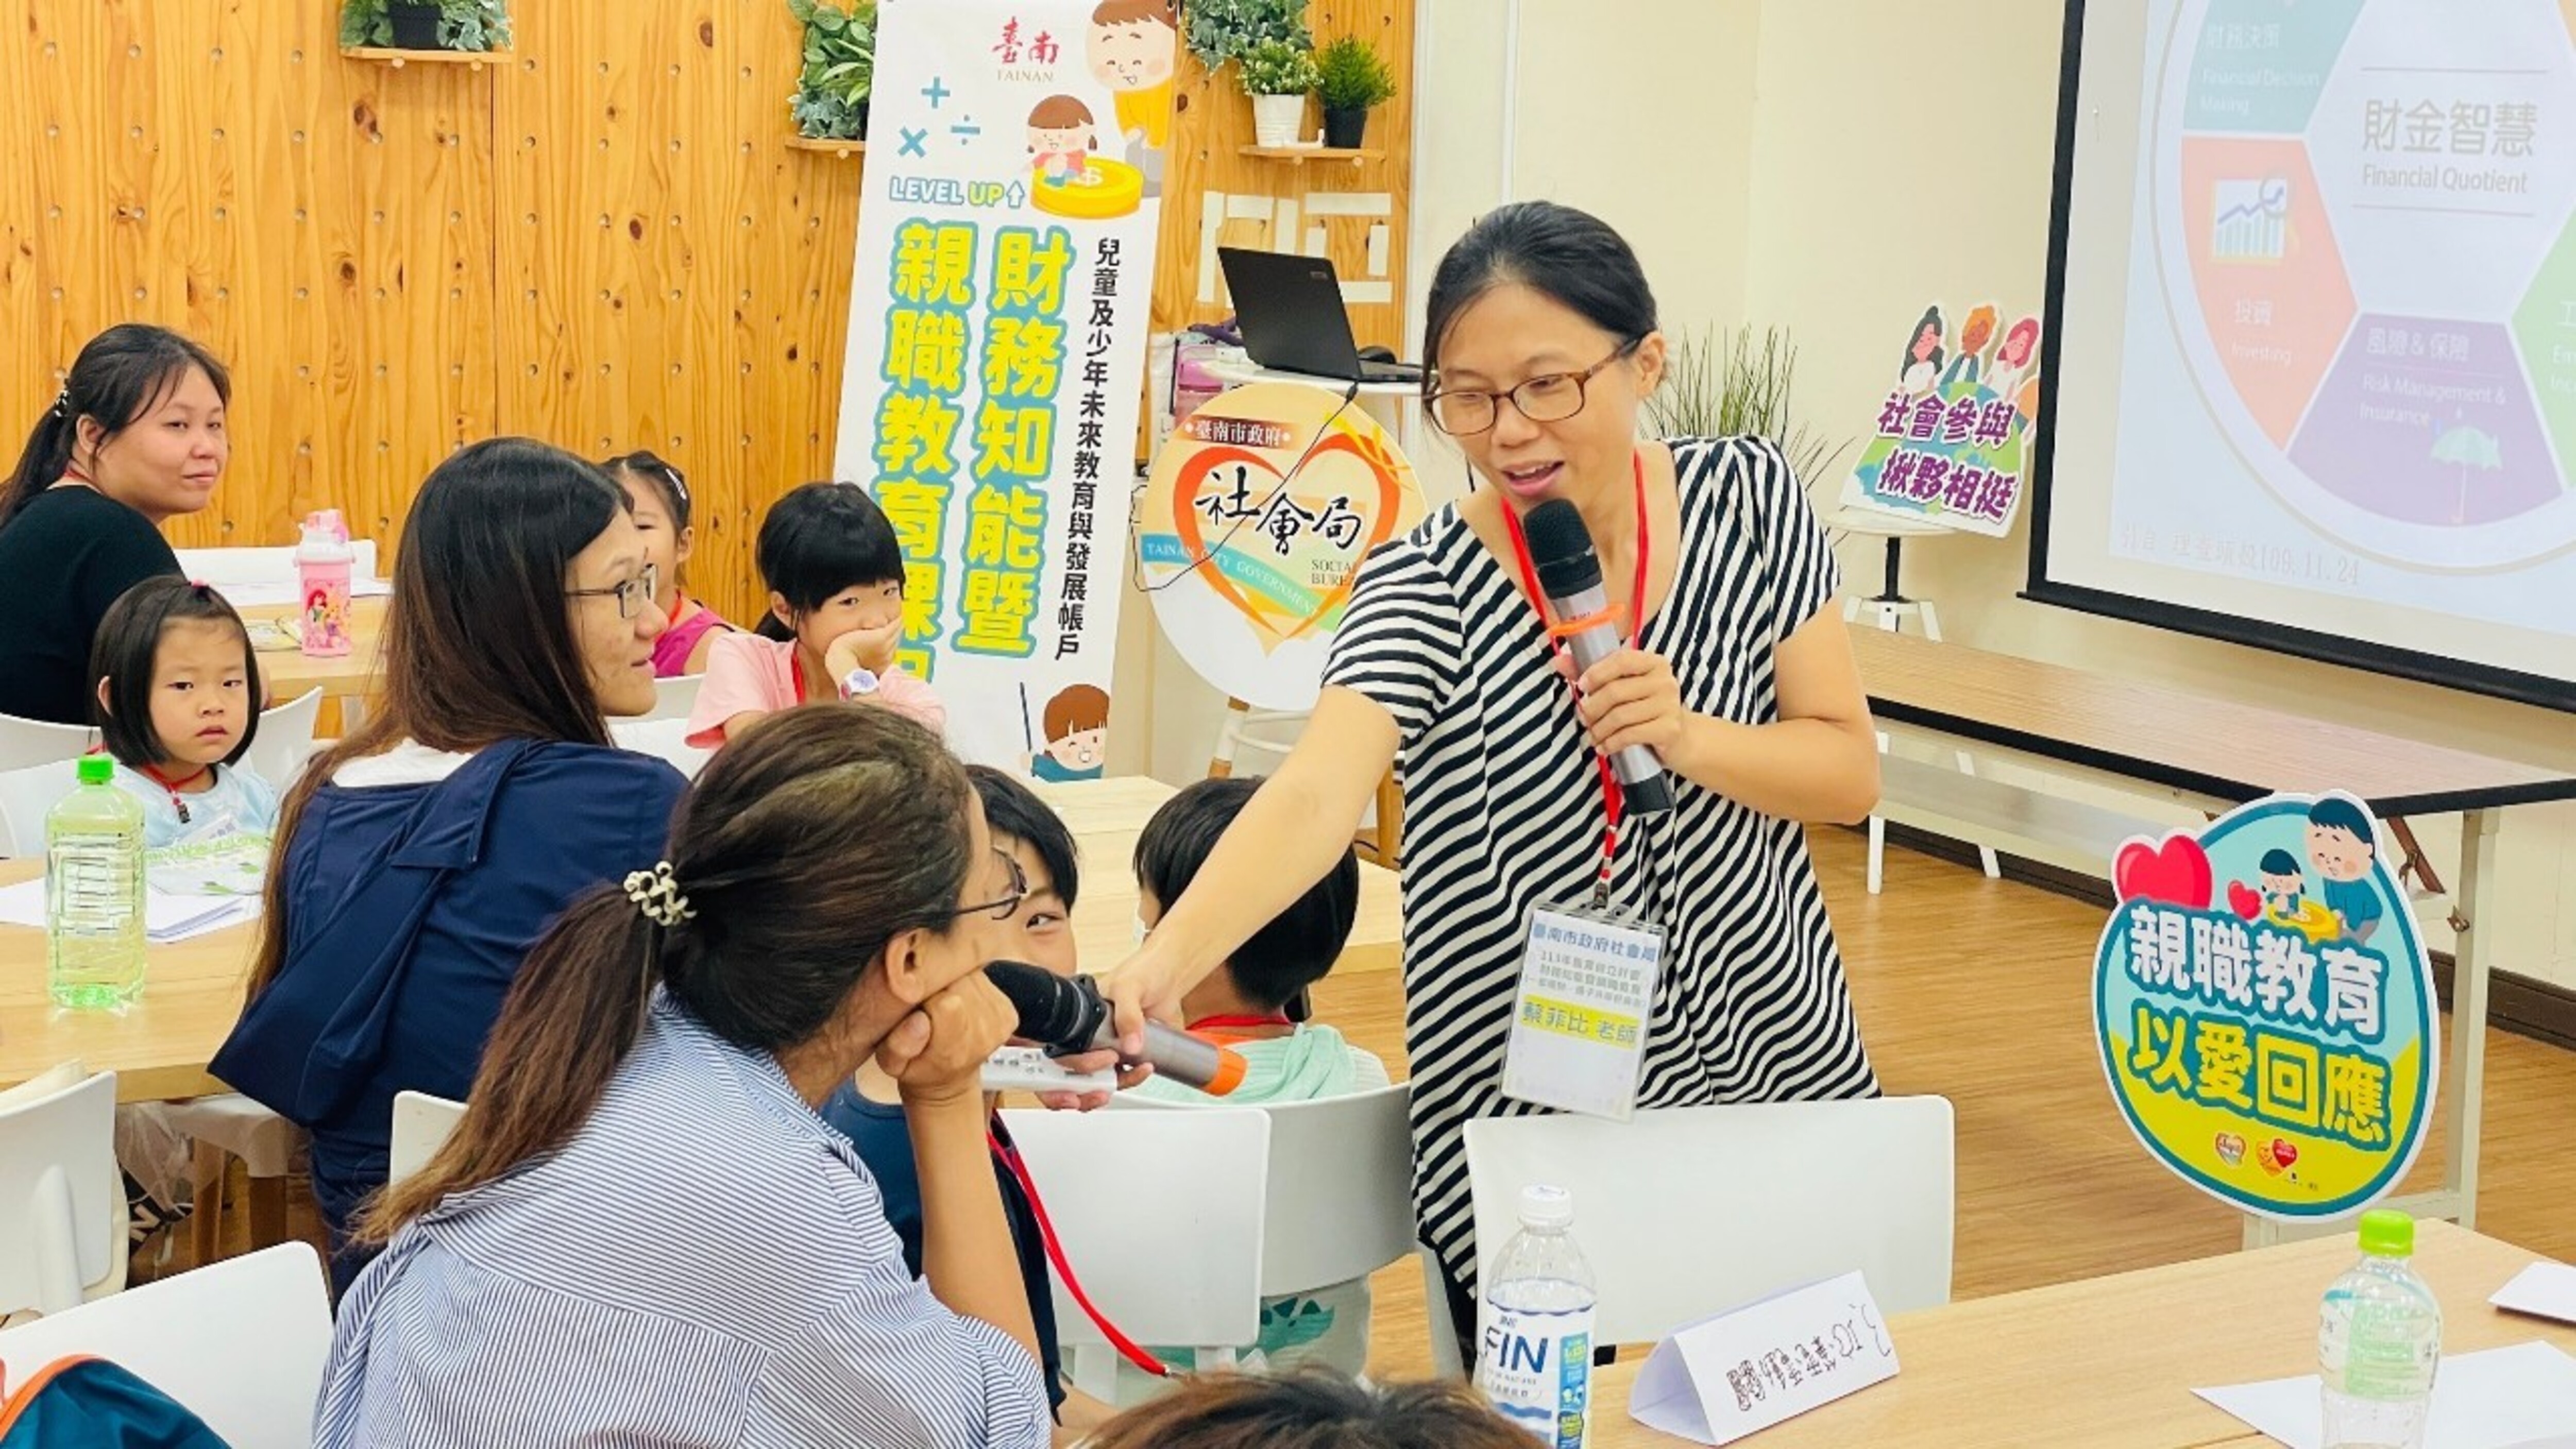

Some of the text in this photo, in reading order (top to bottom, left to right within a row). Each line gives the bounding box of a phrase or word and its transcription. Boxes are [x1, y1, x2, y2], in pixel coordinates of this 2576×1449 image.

[992, 16, 1059, 65] 臺南
[997, 69, 1054, 83] TAINAN
[2362, 98, 2538, 158] 財金智慧
[889, 176, 1004, 207] LEVEL UP
[2363, 164, 2528, 194] Financial Quotient
[2363, 373, 2389, 393] Risk
[2393, 377, 2492, 403] Management
[2551, 374, 2576, 393] Inc
[953, 228, 1073, 654] 財務知能暨
[1194, 420, 1282, 447] 臺南市政府
[1877, 392, 2013, 446] 社會參與
[877, 221, 975, 682] 親職教育課
[1055, 237, 1120, 661] 兒童及少年未來教育與發展帳戶
[1195, 466, 1362, 555] 社會局
[1878, 451, 2018, 519] 揪夥相挺
[1236, 560, 1319, 616] GOVERNMENT
[1311, 559, 1352, 571] SOCIA
[2129, 905, 2382, 1036] 親職教育
[2132, 1007, 2387, 1144] 以愛回應
